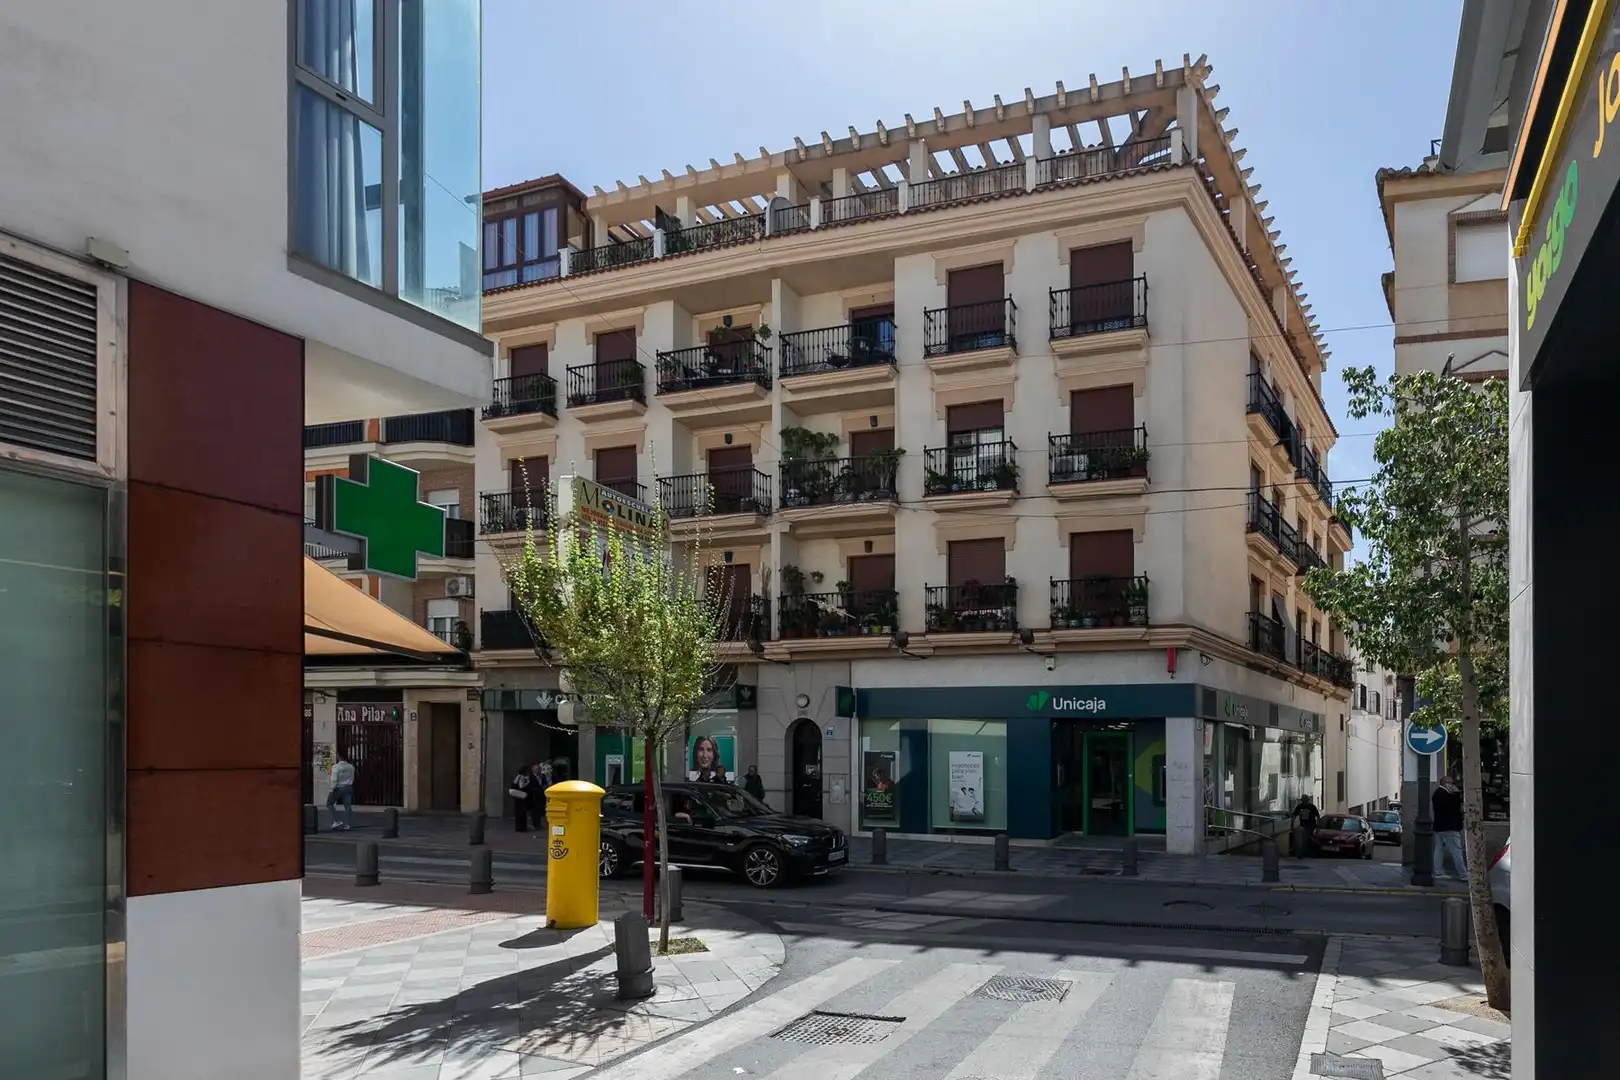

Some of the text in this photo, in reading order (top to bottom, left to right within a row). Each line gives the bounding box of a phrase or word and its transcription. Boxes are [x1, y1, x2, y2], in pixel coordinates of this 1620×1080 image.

[1053, 697, 1106, 713] Unicaja
[337, 706, 386, 722] Ana Pilar
